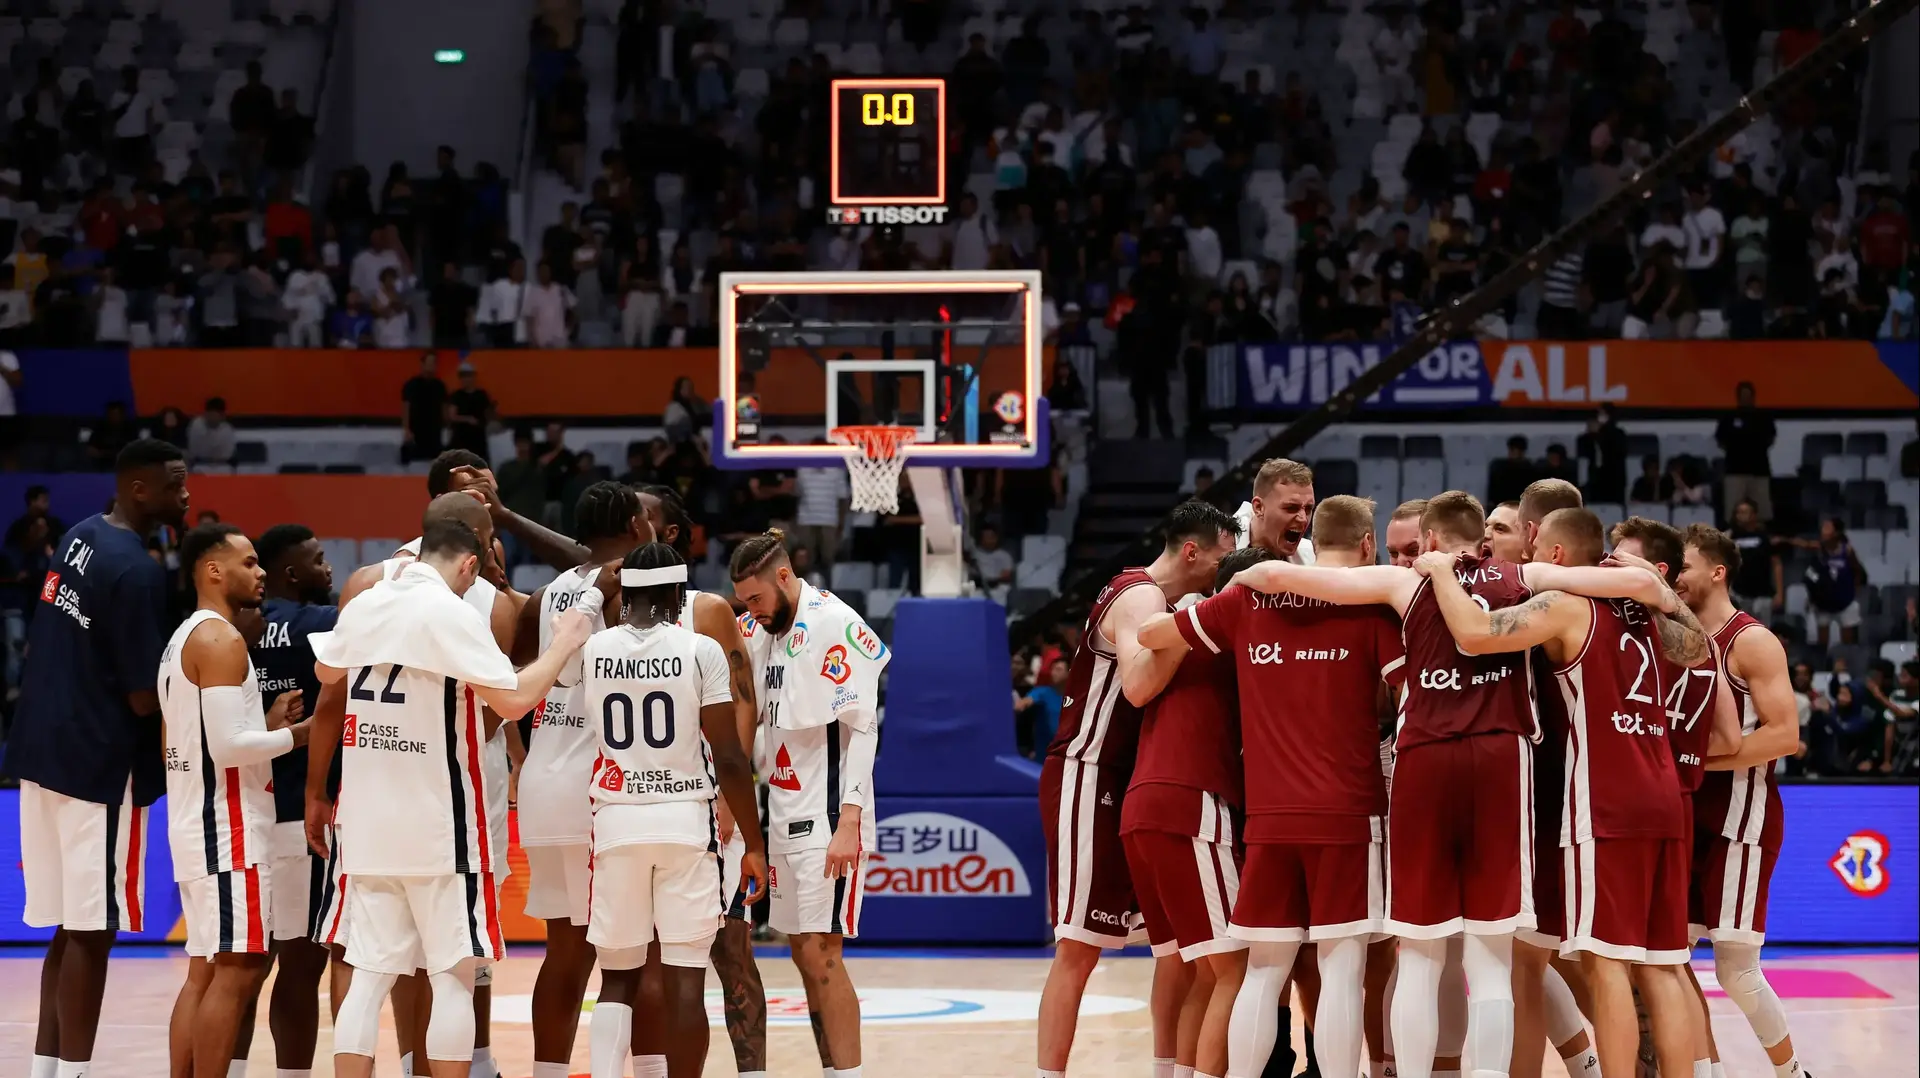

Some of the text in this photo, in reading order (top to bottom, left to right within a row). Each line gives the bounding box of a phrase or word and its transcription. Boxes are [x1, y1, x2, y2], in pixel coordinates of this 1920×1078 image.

[862, 93, 914, 125] 0.0
[861, 207, 949, 224] TISSOT
[1245, 345, 1380, 404] WIN
[1490, 345, 1627, 402] ALL
[1247, 642, 1284, 665] tet
[594, 657, 683, 680] FRANCISCO
[1420, 668, 1462, 691] tet
[1665, 667, 1717, 733] 47
[602, 690, 676, 751] 00
[1611, 711, 1645, 735] tet
[623, 769, 673, 781] CAISSE
[627, 778, 704, 795] D'EPARGNE
[877, 825, 979, 855] 百岁山
